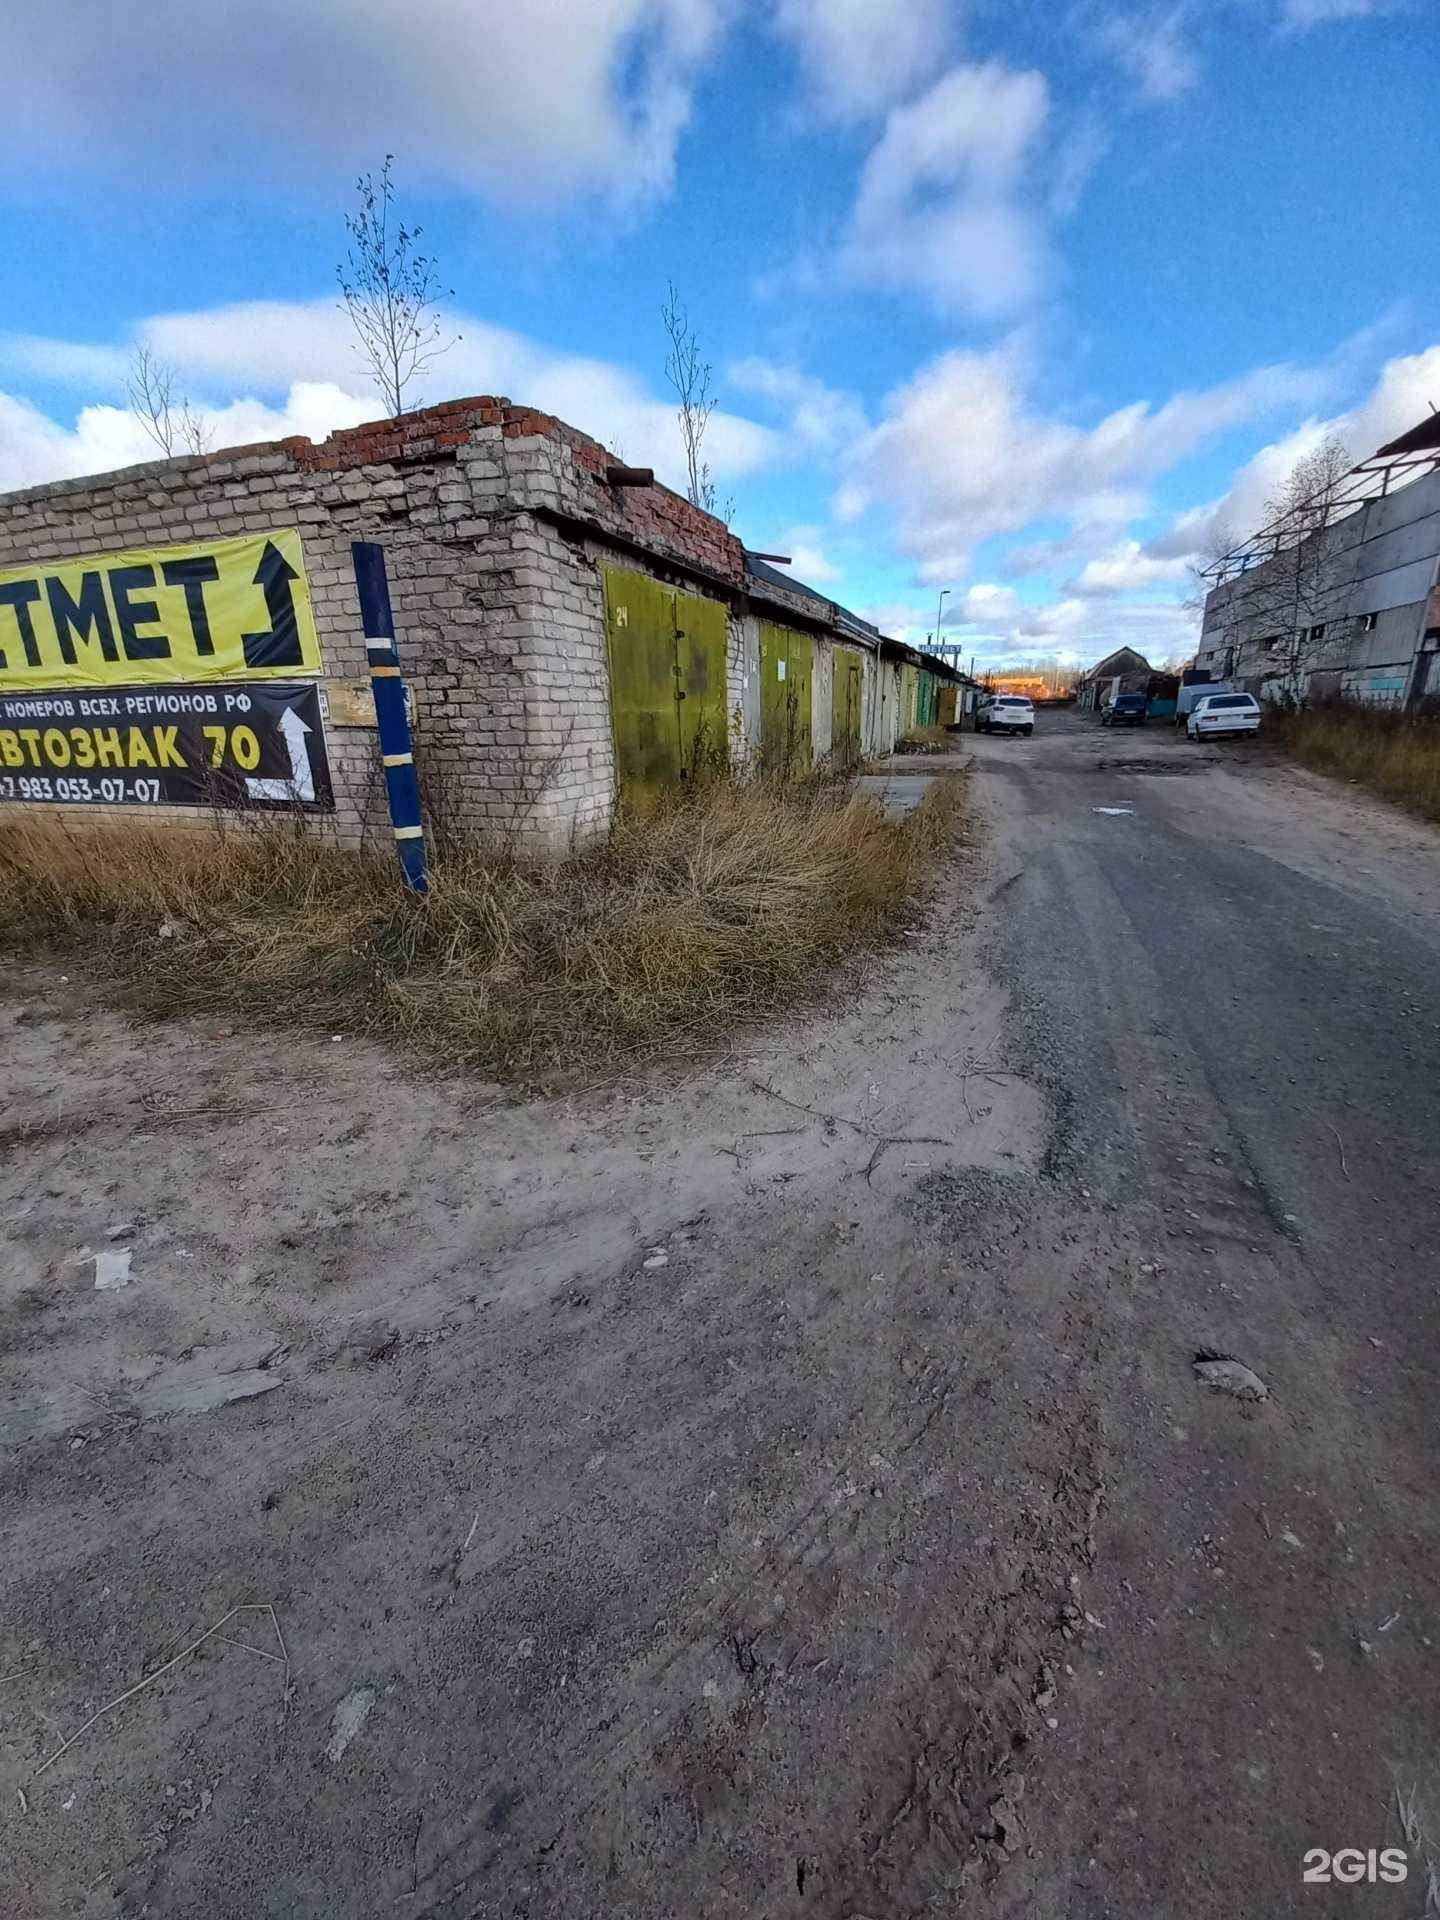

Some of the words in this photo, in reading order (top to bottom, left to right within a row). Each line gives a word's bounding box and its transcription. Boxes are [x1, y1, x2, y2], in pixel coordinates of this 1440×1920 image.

[0, 556, 220, 668] ТМЕТ
[616, 606, 628, 627] 24
[4, 701, 75, 717] НОМЕРОВ
[79, 698, 121, 716] ВСЕХ
[125, 694, 218, 714] РЕГИОНОВ
[224, 693, 252, 712] РФ
[0, 726, 189, 768] ВТОЗНАК
[202, 725, 261, 770] 70
[18, 776, 54, 799] 983
[56, 778, 160, 802] 053-07-07
